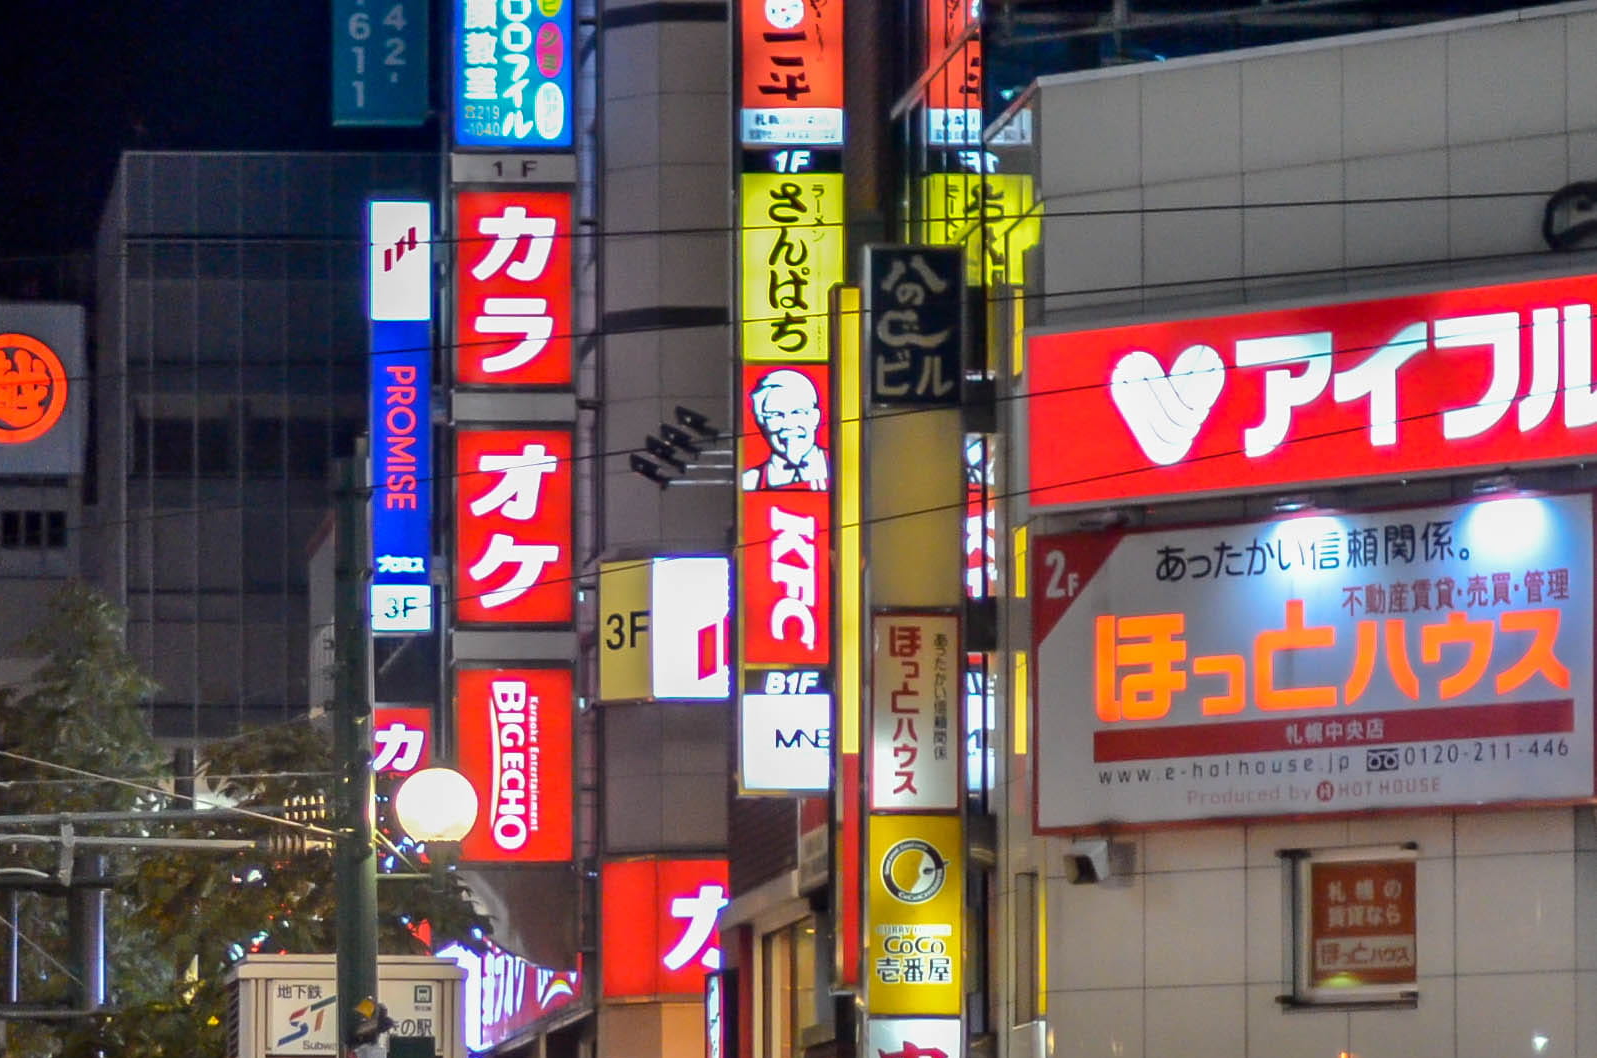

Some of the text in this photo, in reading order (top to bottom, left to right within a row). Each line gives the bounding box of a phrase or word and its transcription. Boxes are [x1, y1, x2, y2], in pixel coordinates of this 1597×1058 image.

[774, 151, 811, 173] 1F
[768, 183, 809, 353] さんぱち
[1236, 304, 1597, 458] アイフル
[386, 366, 417, 510] PROMISE
[770, 505, 815, 651] KFC
[1045, 549, 1079, 599] 2F
[384, 597, 419, 619] 3F
[605, 611, 650, 650] 3F
[1095, 599, 1571, 722] ほっとハウス
[765, 671, 819, 695] B1F
[889, 625, 922, 796] ほっとハウス
[491, 681, 527, 850] BIG ECHO
[530, 696, 540, 832] Karaoke Entertainment
[1403, 738, 1570, 768] 0120-211-446
[1187, 785, 1283, 806] Produced
[1289, 783, 1313, 805] by
[1338, 780, 1372, 798] HOT
[1378, 777, 1441, 796] HOUSE
[884, 935, 945, 954] CoCo
[276, 983, 322, 1000] 地下鉄
[876, 957, 951, 983] 壱番屋
